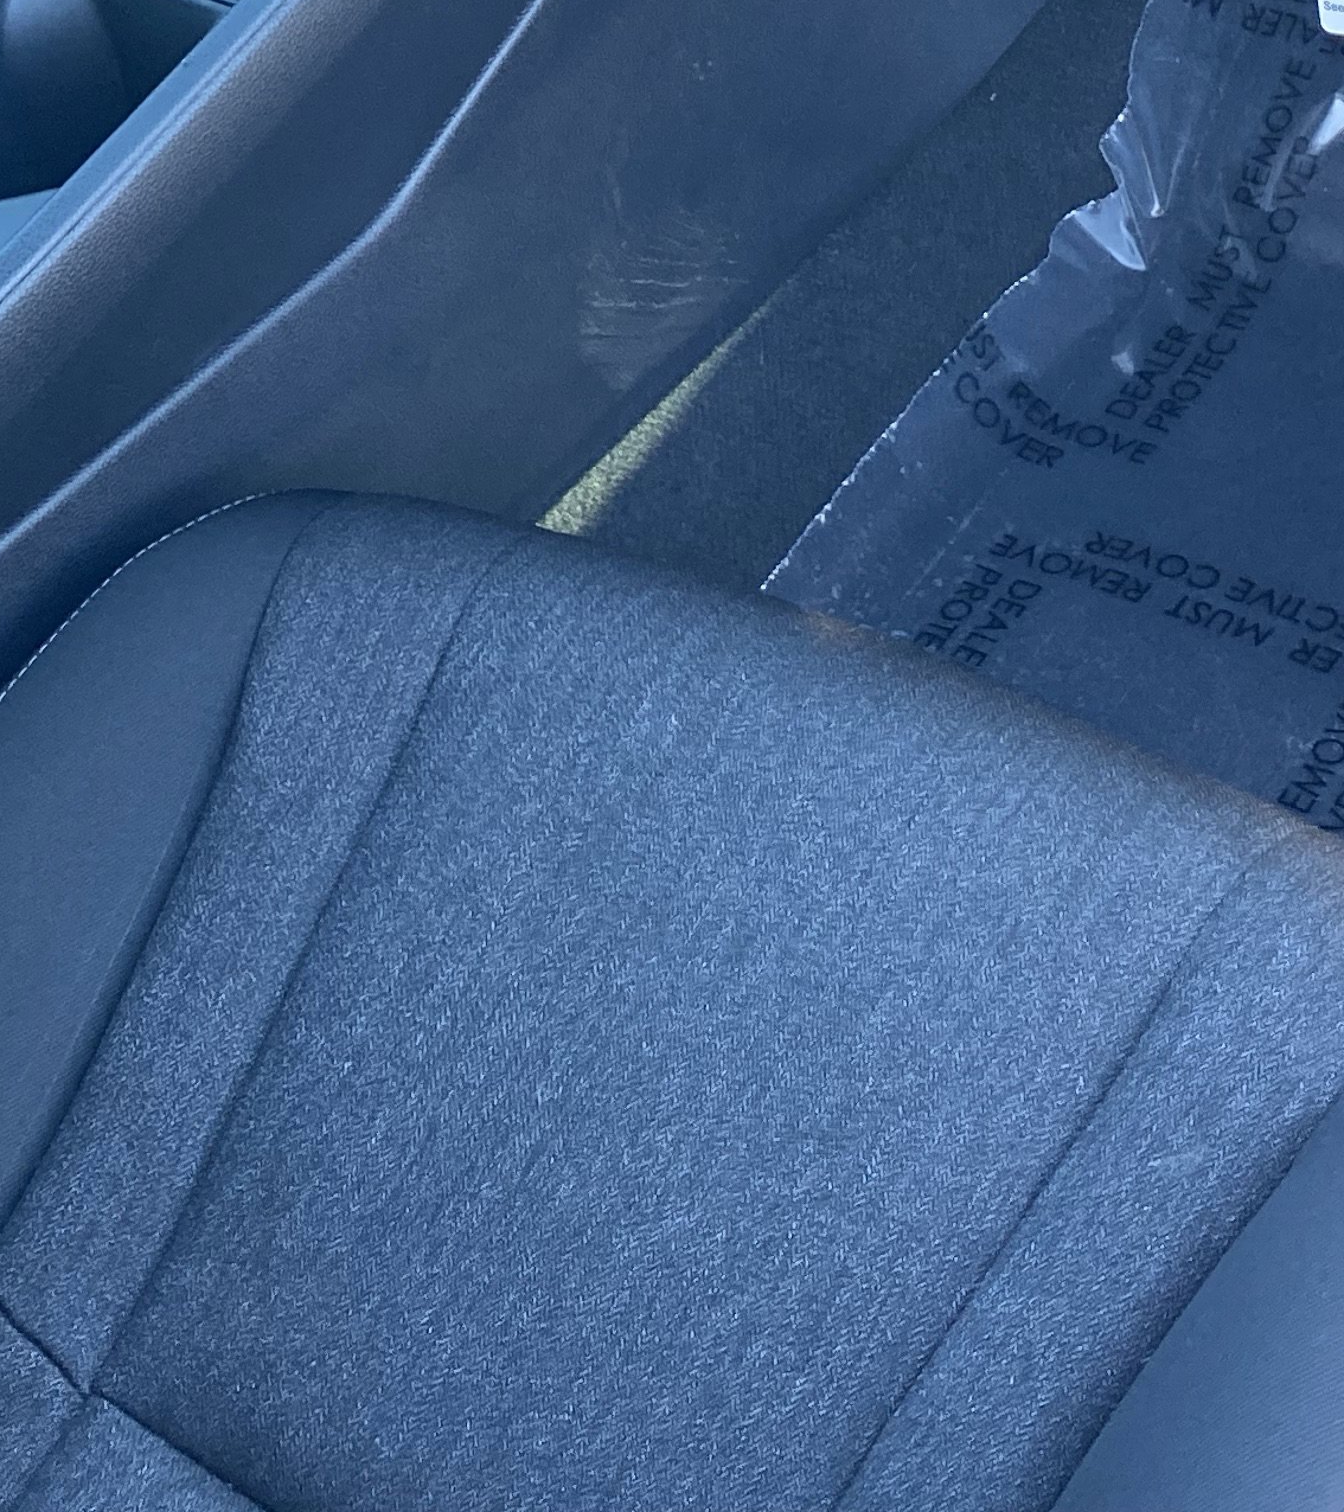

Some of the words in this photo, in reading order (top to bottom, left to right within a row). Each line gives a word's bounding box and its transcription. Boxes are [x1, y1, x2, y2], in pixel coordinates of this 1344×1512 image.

[1323, 0, 1344, 12] See
[1106, 324, 1197, 420] DEALER
[1188, 224, 1246, 311] MUST
[1233, 58, 1317, 210] REMOVE
[1144, 276, 1272, 433] PROTECTIVE
[1256, 135, 1318, 264] COVER
[956, 372, 1064, 468] COVER
[1008, 380, 1155, 466] REMOVE
[987, 532, 1154, 604] REMOVE
[1084, 530, 1221, 590] COVER
[952, 577, 1044, 670] DEALE
[1165, 594, 1276, 648] MUST
